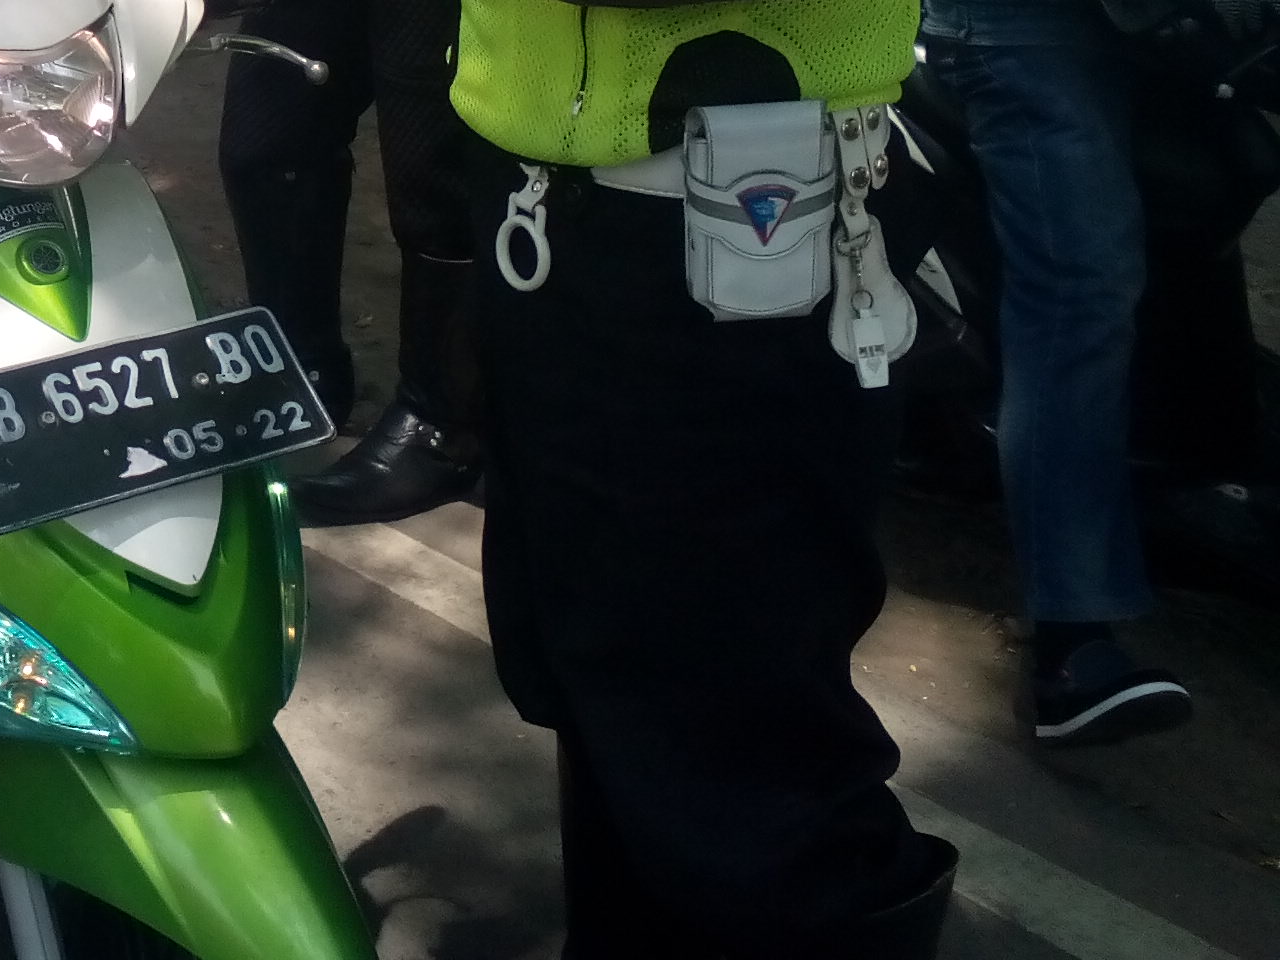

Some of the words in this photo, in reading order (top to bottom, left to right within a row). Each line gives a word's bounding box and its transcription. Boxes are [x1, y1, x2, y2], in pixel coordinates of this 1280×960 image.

[42, 347, 179, 424] 6527
[163, 419, 224, 461] 05
[253, 401, 312, 440] 22
